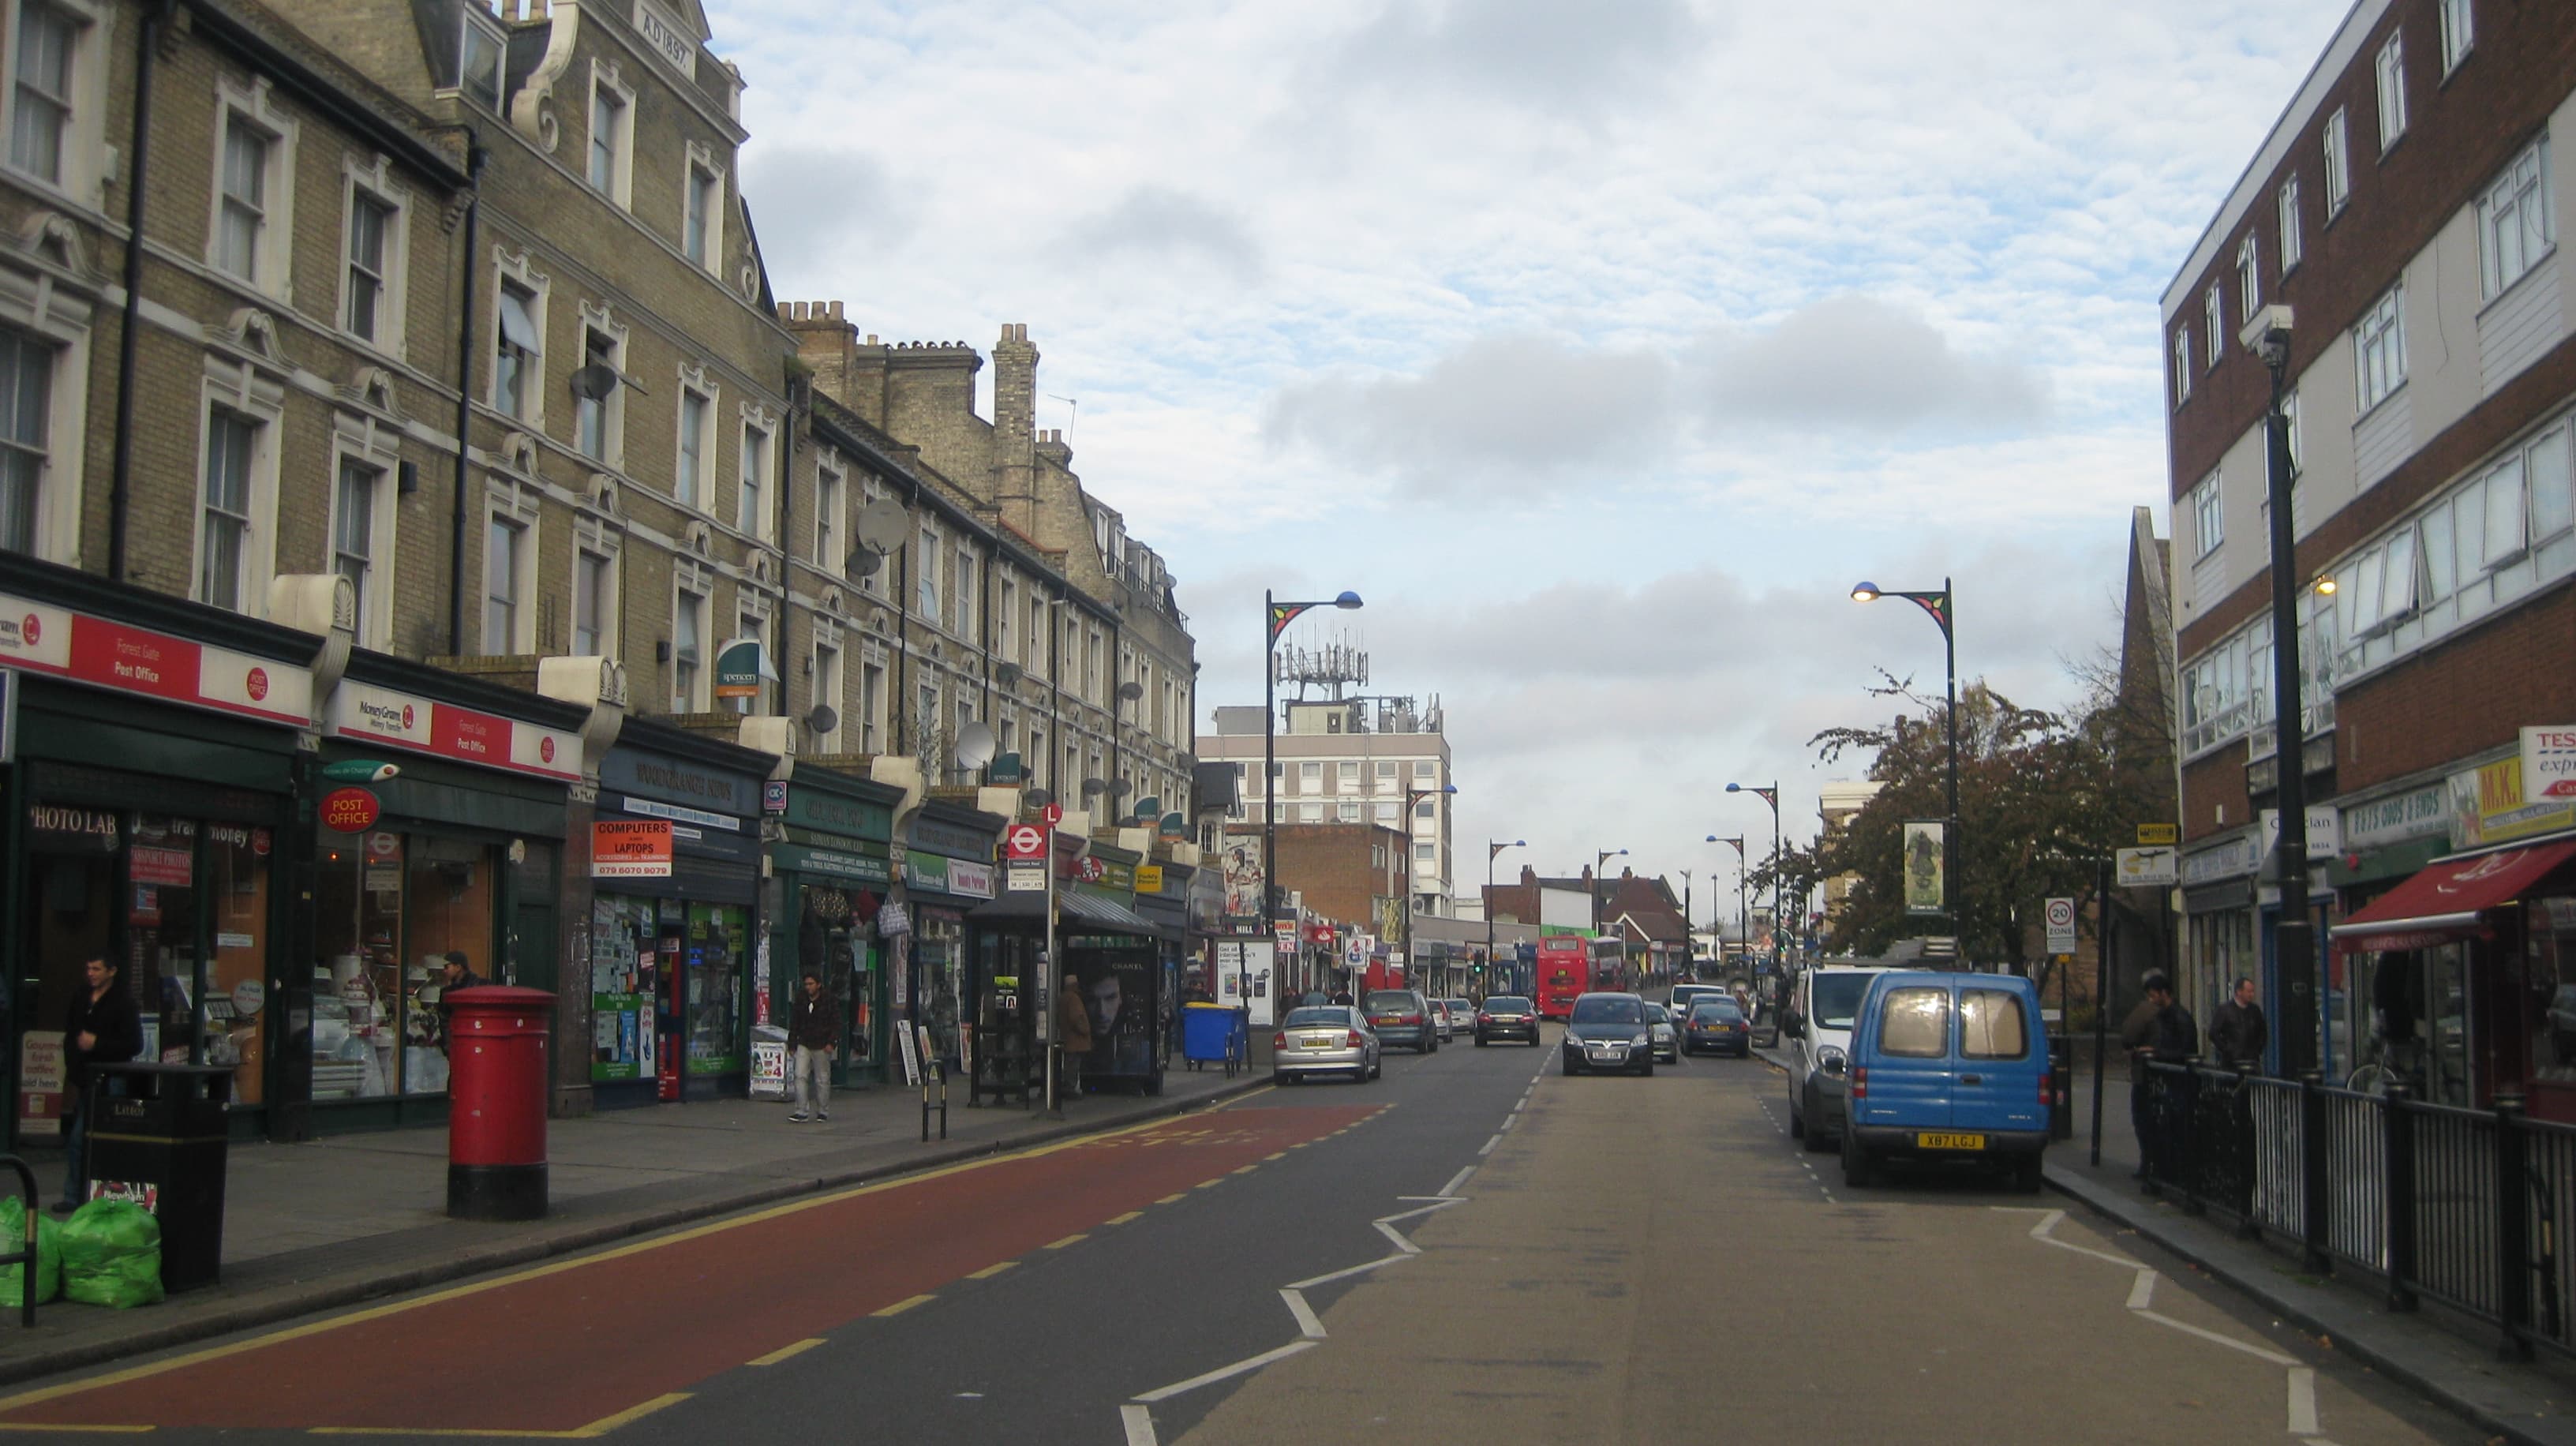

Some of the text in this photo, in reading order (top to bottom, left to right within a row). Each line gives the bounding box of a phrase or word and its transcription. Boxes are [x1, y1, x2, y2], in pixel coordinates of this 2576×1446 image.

[114, 661, 159, 683] Post Office
[360, 701, 400, 720] MoneyGram
[458, 737, 486, 754] Post Office
[333, 800, 364, 811] POST
[328, 812, 369, 825] OFFICE
[1047, 807, 1057, 822] L
[87, 811, 116, 835] LAB
[598, 822, 668, 834] COMPUTERS
[615, 843, 653, 853] LAPTOPS
[2053, 908, 2068, 917] 20
[1236, 924, 1254, 934] HILL
[25, 1039, 64, 1051] Gourme
[39, 1077, 58, 1088] here
[114, 1103, 146, 1116] Litter
